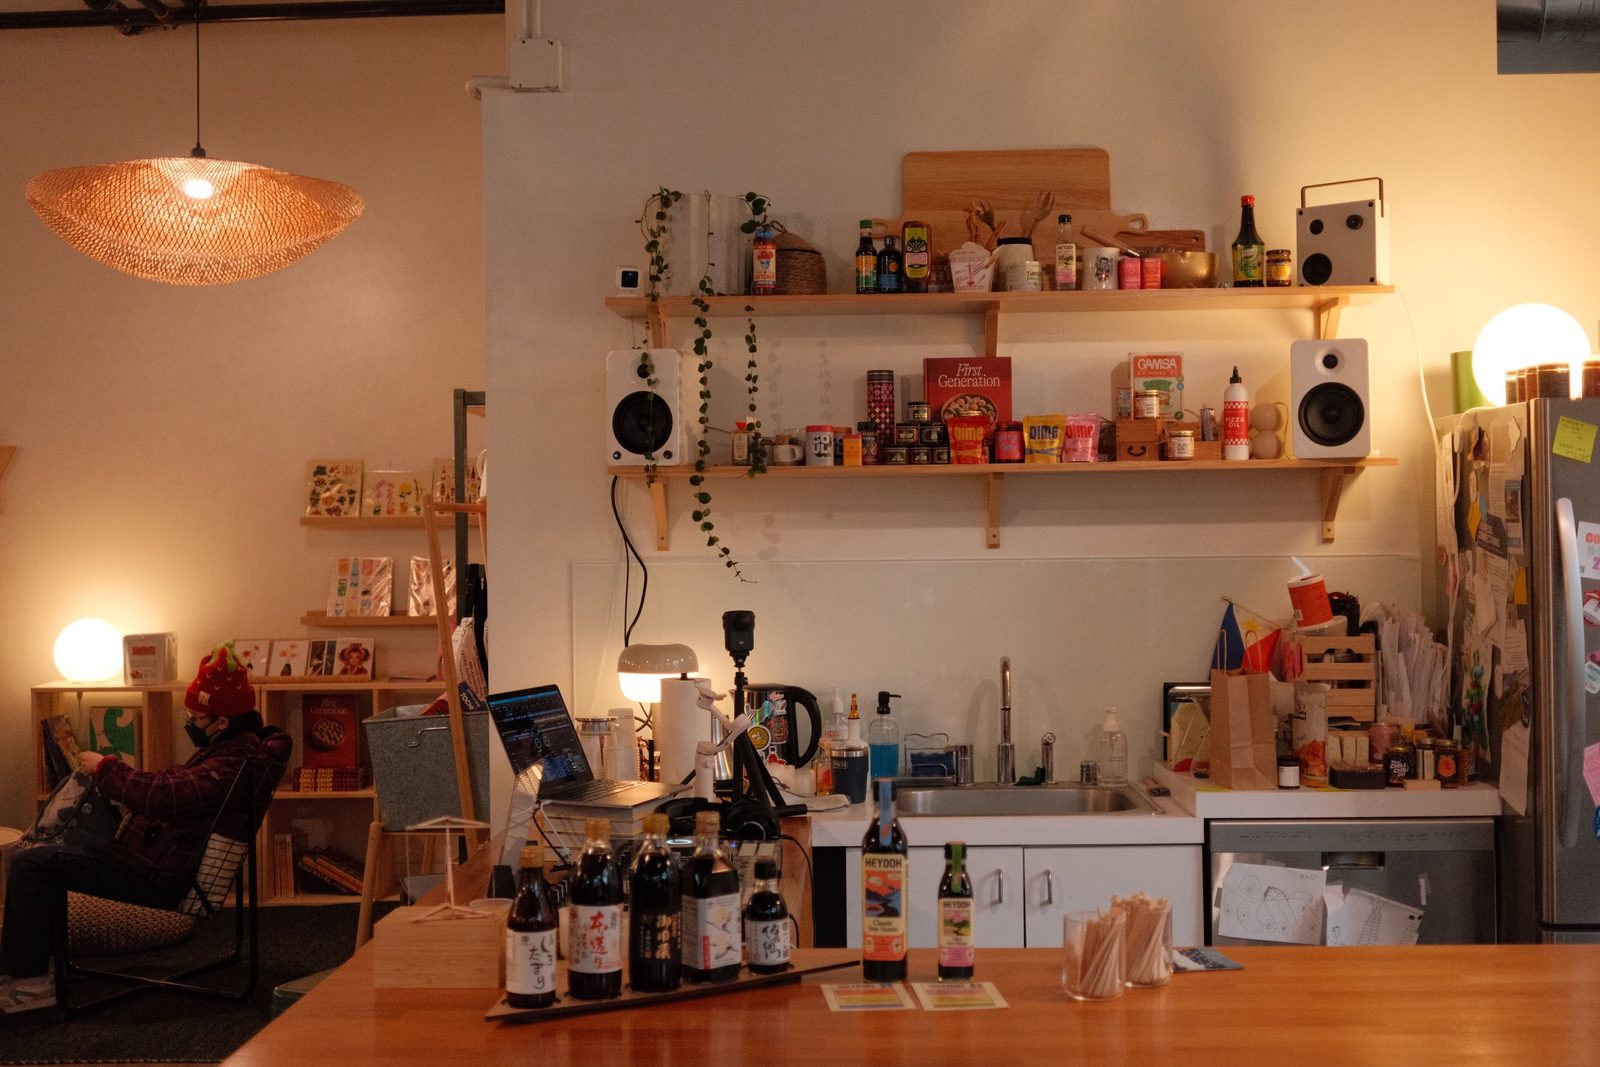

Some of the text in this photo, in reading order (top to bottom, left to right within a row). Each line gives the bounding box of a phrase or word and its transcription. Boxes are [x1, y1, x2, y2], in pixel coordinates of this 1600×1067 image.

[957, 363, 982, 376] First
[1137, 358, 1177, 370] GAMSA
[938, 374, 1001, 388] Generation
[865, 858, 902, 869] HEYDOH
[529, 946, 545, 990] たまり
